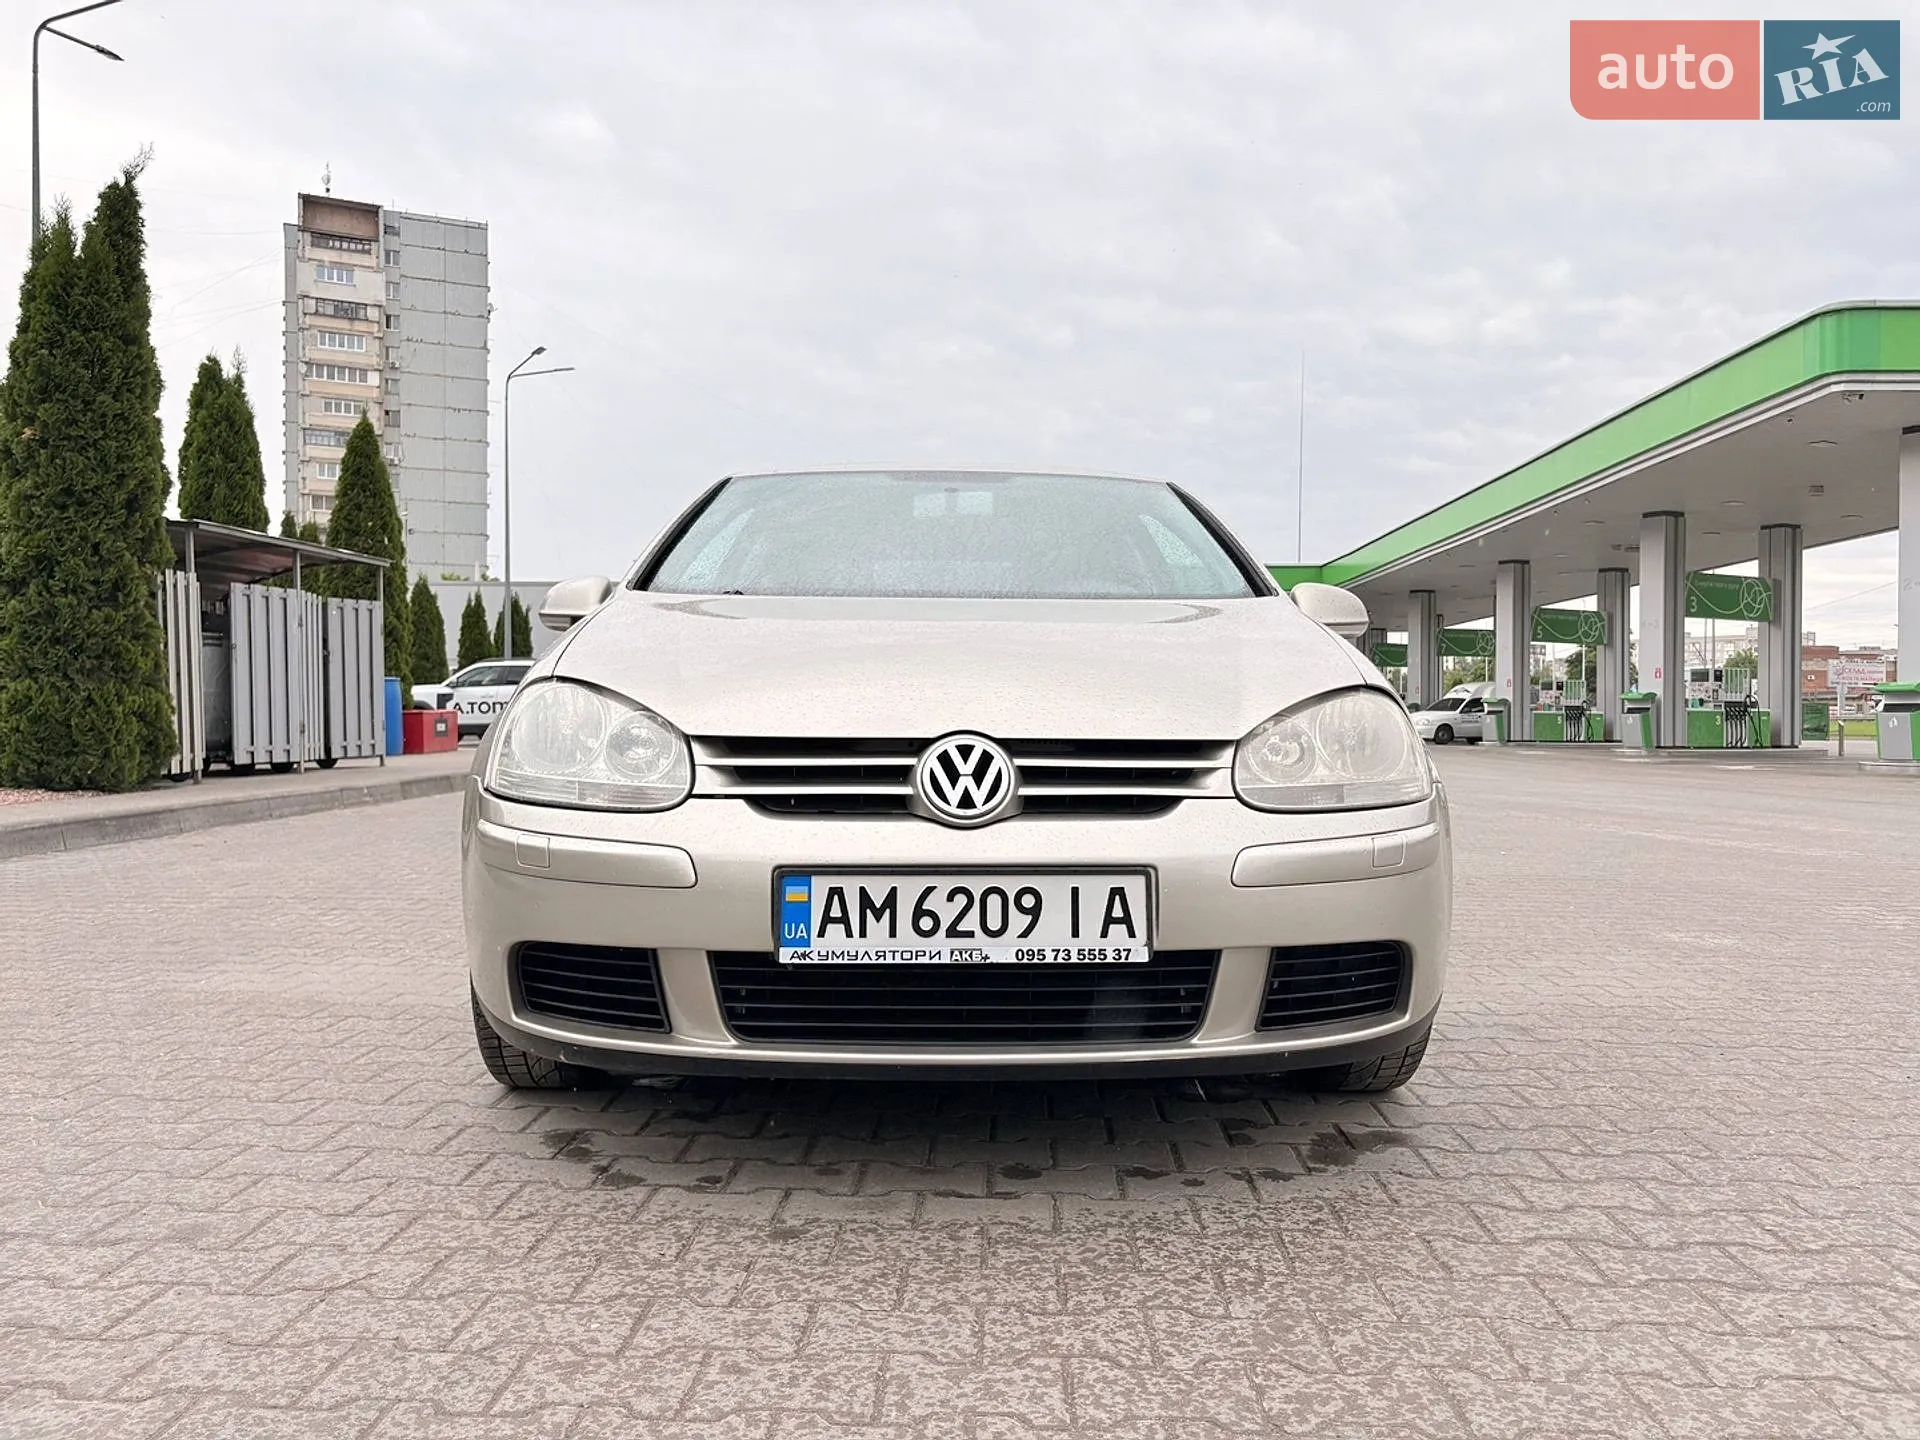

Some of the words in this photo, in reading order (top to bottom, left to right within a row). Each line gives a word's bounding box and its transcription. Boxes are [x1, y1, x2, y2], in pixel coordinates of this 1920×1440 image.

[1690, 596, 1698, 612] 3
[1536, 626, 1543, 638] 5
[1715, 715, 1721, 725] 3
[817, 886, 898, 938] AM
[911, 885, 1043, 938] 6209
[1071, 886, 1136, 938] IA
[784, 923, 808, 939] UA
[1015, 949, 1046, 961] 095
[1051, 949, 1071, 961] 73
[1076, 949, 1107, 961] 555
[1112, 949, 1131, 961] 37
